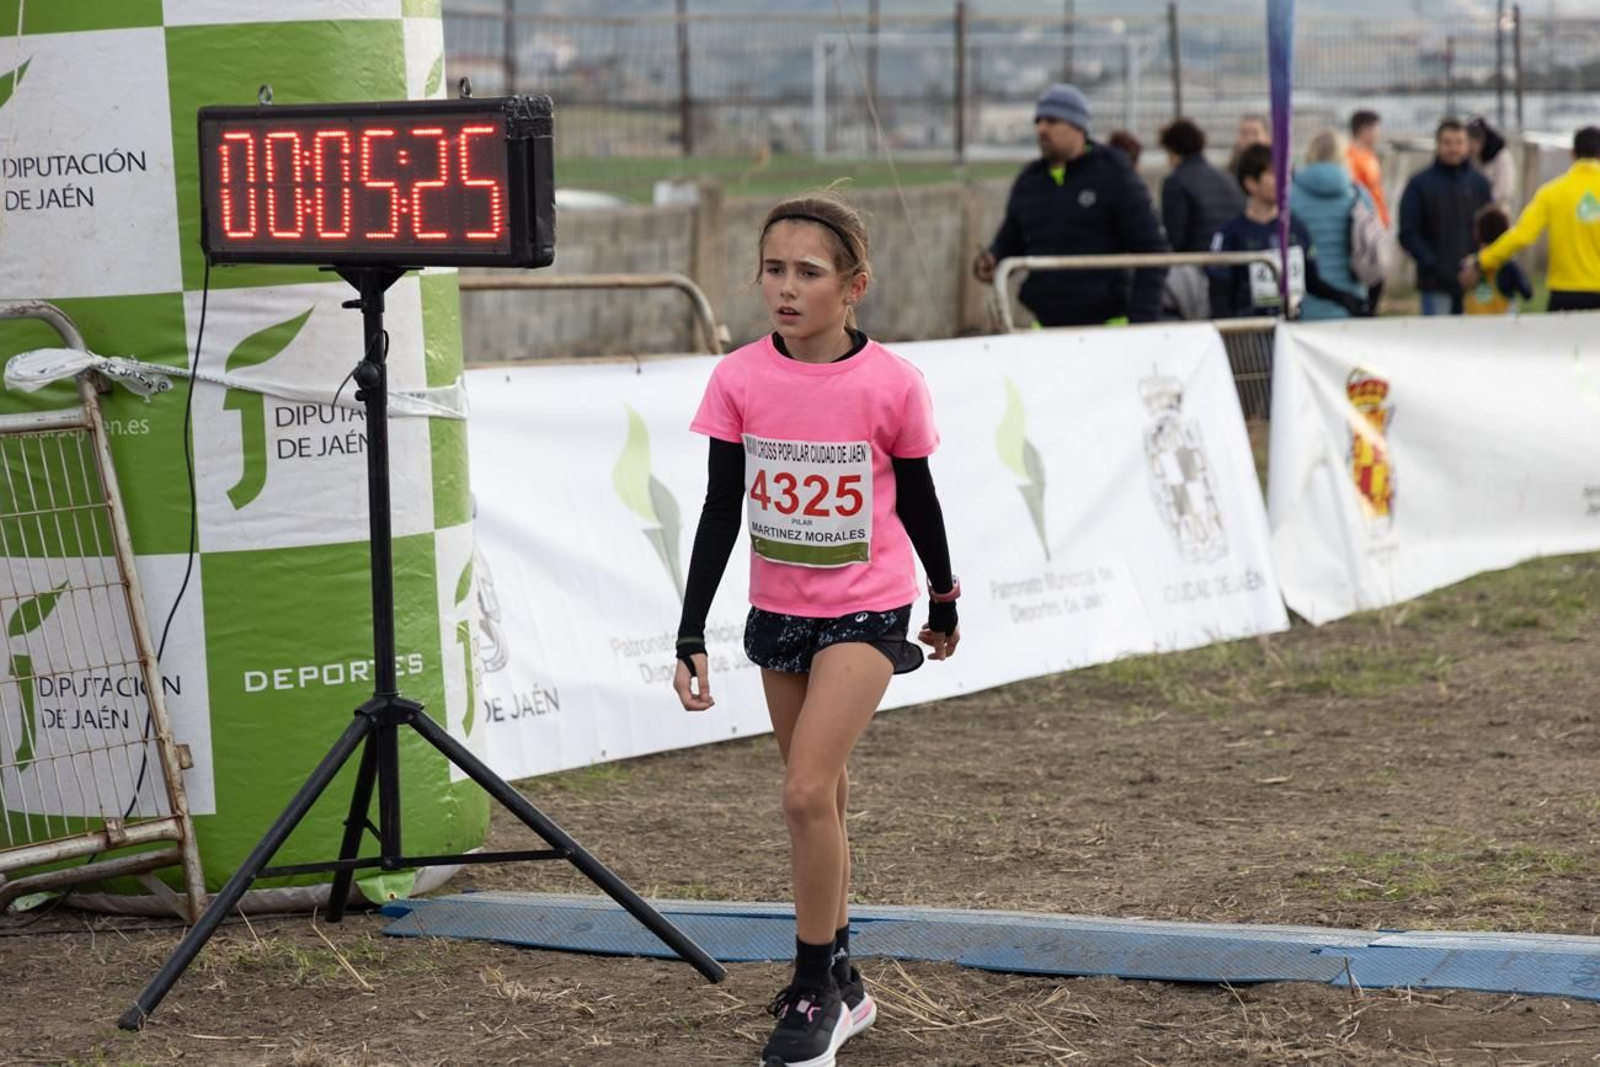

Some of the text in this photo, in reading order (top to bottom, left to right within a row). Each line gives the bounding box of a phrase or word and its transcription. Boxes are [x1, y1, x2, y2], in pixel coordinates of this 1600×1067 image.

[2, 148, 147, 179] DIPUTACIÓN
[218, 126, 502, 239] 00:05:25
[5, 183, 94, 211] DE JAÉN
[275, 404, 367, 428] DIPUTA
[277, 437, 312, 460] DE
[778, 443, 809, 462] POPULAR
[810, 445, 835, 463] CIUDAD
[837, 445, 847, 463] DE
[750, 469, 863, 517] 4325
[751, 521, 866, 542] MARTINEZ MORALES
[791, 518, 813, 526] PILAR
[244, 652, 423, 692] DEPORES
[511, 683, 560, 719] JAÉN
[42, 705, 129, 729] DE JAÉN
